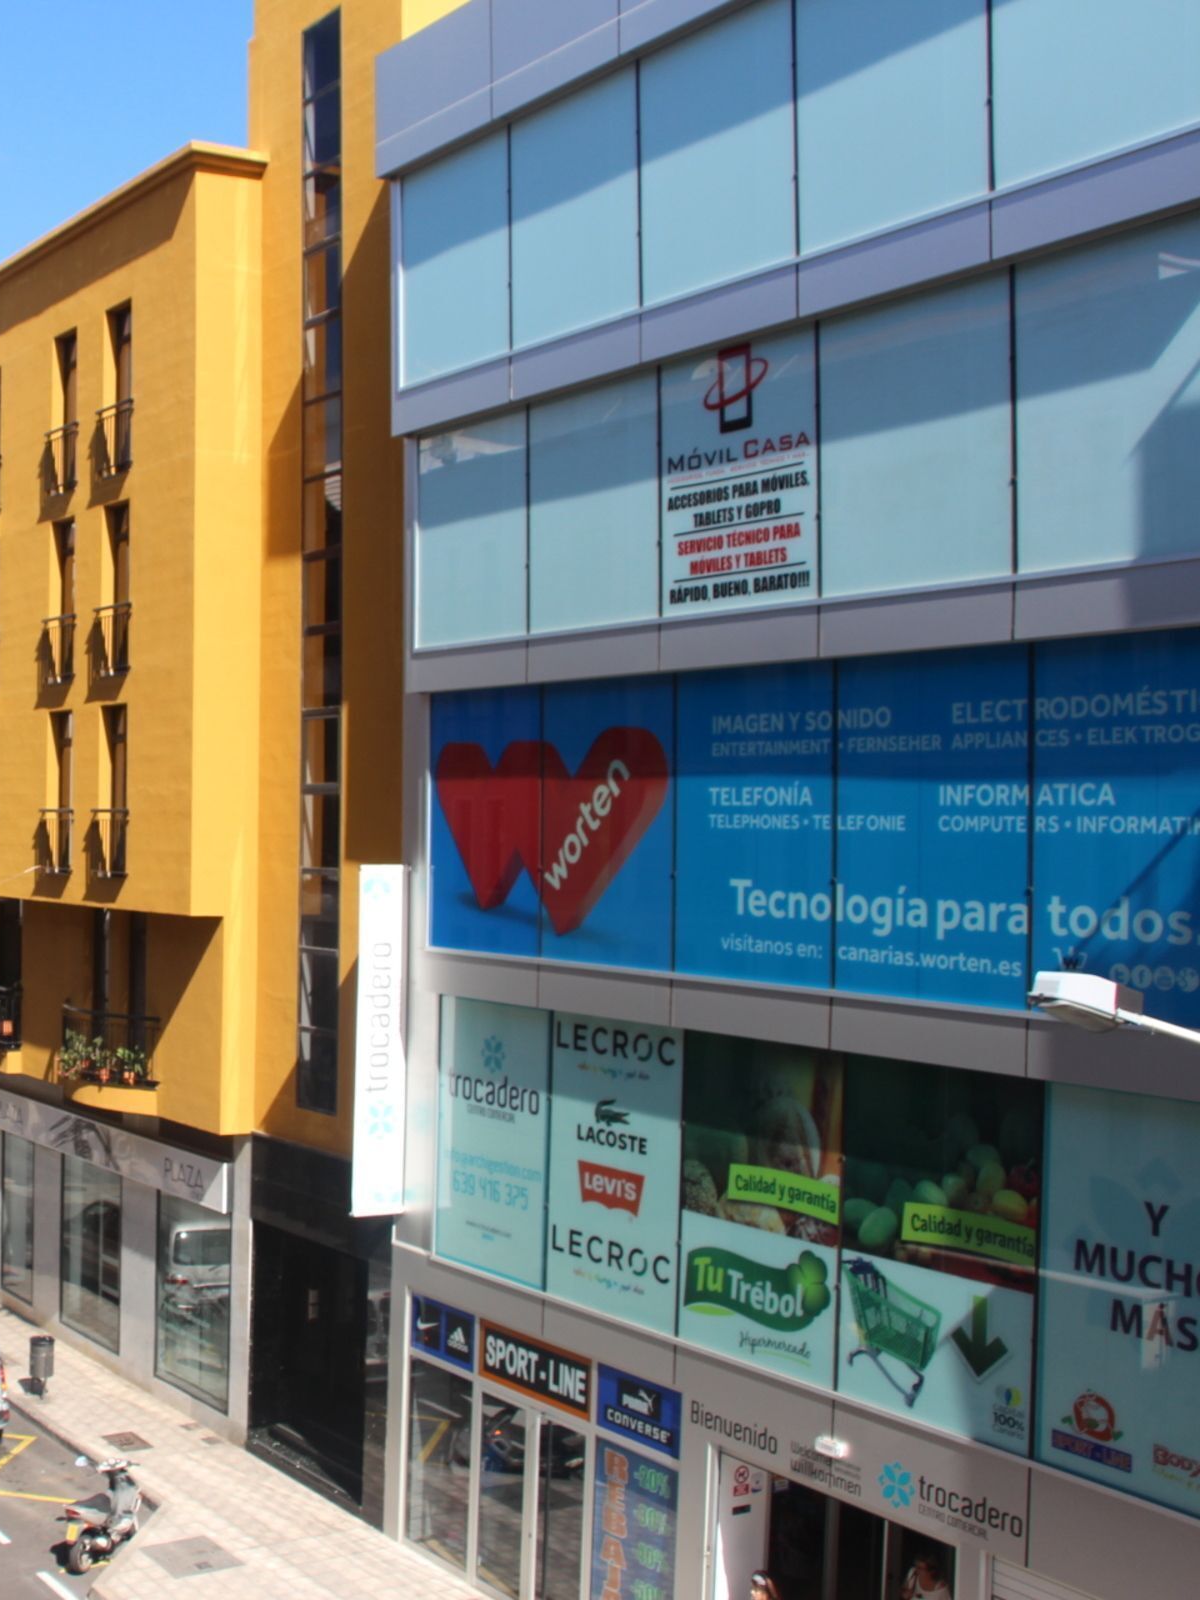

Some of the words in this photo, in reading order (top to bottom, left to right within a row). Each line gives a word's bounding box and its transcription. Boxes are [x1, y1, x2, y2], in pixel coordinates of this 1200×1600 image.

[668, 447, 738, 474] MÓVIL
[743, 432, 810, 459] CASA
[668, 485, 730, 511] ACCESORIOS
[732, 481, 759, 499] PARA
[693, 507, 735, 528] TABLETS
[736, 505, 743, 520] Y
[745, 498, 781, 518] GOPRO
[678, 536, 724, 556] SERVICIO
[727, 528, 770, 548] TÉCNICO
[773, 522, 801, 540] PARA
[690, 554, 732, 576] MÓVILES
[735, 554, 742, 568] Y
[744, 547, 787, 567] TABLETS
[754, 570, 810, 593] BARATO!!!
[712, 713, 784, 735] IMAGEN
[788, 712, 801, 732] Y
[805, 706, 891, 732] SONIDO
[952, 685, 1200, 724] ELECTRODOMÉSTI
[712, 738, 832, 757] ENTERTAINMENT
[848, 734, 942, 752] FERNSEHER
[952, 729, 1071, 750] APPLIANCES
[709, 781, 813, 806] TELEFONÍA
[939, 782, 1116, 806] INFORMATICA
[544, 759, 631, 890] worten
[708, 814, 800, 830] TELEPHONES
[813, 814, 906, 831] TELEFONIE
[938, 815, 1060, 833] COMPUTERS
[730, 878, 928, 937] Tecnología
[936, 898, 1029, 940] para
[796, 942, 823, 959] en:
[838, 945, 1022, 977] canarias.worten.es
[365, 942, 392, 1093] trocadero
[556, 1021, 676, 1066] LECROC
[449, 1067, 540, 1115] trocadero
[577, 1124, 648, 1155] LACOSTE
[164, 1157, 204, 1188] PLAZA
[735, 1174, 776, 1195] Calidad
[778, 1184, 785, 1202] y
[787, 1186, 836, 1214] garantía
[911, 1213, 962, 1237] Calidad
[965, 1224, 973, 1243] y
[975, 1228, 1034, 1257] garantía
[1144, 1201, 1170, 1237] Y
[552, 1224, 671, 1284] LECROC
[693, 1256, 724, 1293] Tu
[727, 1268, 804, 1318] Trébol
[606, 1408, 670, 1443] CONVERSE
[992, 1412, 1025, 1432] 100%
[919, 1476, 1023, 1537] trocadero
